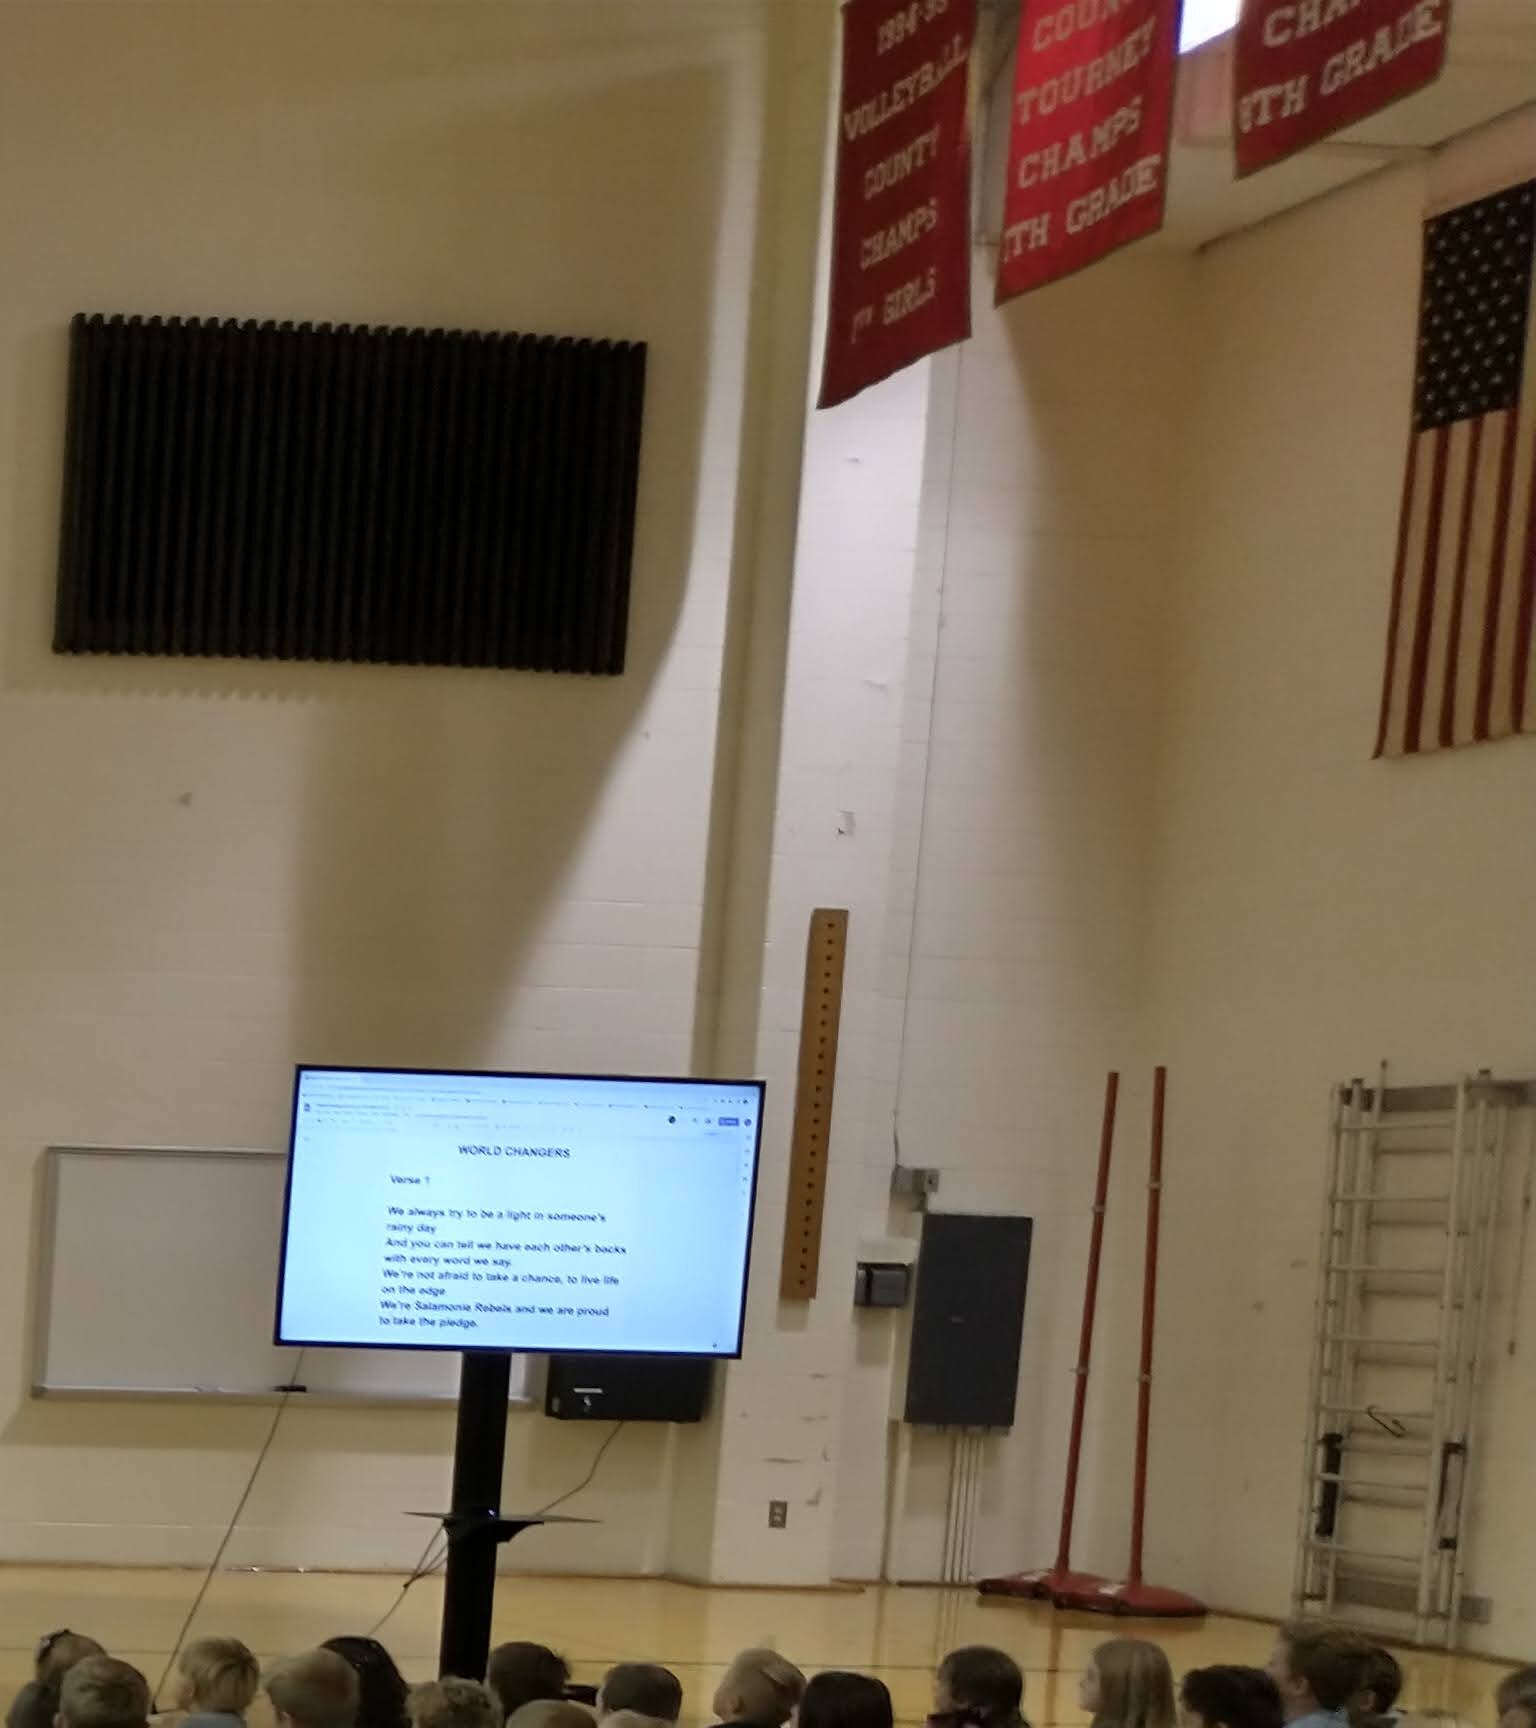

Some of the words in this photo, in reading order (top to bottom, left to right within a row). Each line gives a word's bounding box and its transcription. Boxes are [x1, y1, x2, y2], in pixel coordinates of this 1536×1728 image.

[1320, 0, 1442, 96] GRADE
[1016, 15, 1158, 126] TOURNEY
[1017, 95, 1143, 189] CHAMPS
[864, 122, 941, 200] COUNTY
[1066, 152, 1162, 235] GRADE
[860, 197, 938, 269] CHAMPS
[883, 265, 937, 325] GIRLS
[457, 1144, 503, 1157] WORLD
[504, 1146, 571, 1159] CHANGERS
[390, 1175, 421, 1185] Verse
[387, 1205, 405, 1216] We
[407, 1207, 446, 1219] always
[448, 1208, 464, 1220] try
[466, 1209, 478, 1219] to
[480, 1209, 495, 1219] be
[496, 1211, 504, 1220] a
[506, 1210, 532, 1222] light
[533, 1211, 545, 1221] in
[386, 1223, 414, 1234] rainy
[416, 1223, 437, 1235] day
[385, 1237, 408, 1248] And
[410, 1240, 431, 1249] you
[433, 1240, 455, 1249] can
[456, 1240, 474, 1249] tell
[476, 1242, 493, 1251] we
[495, 1240, 522, 1251] have
[523, 1242, 551, 1253] each
[594, 1243, 627, 1255] backs
[383, 1253, 408, 1264] with
[409, 1255, 440, 1267] every
[442, 1257, 471, 1266] word
[473, 1257, 490, 1266] we
[415, 1271, 435, 1281] not
[437, 1271, 470, 1281] afraid
[471, 1271, 484, 1282] to
[485, 1272, 510, 1282] take
[511, 1274, 519, 1283] a
[566, 1275, 579, 1285] to
[580, 1275, 601, 1285] live
[603, 1275, 620, 1285] life
[380, 1285, 396, 1295] on
[398, 1284, 416, 1295] the
[418, 1286, 446, 1298] edge
[413, 1299, 472, 1312] Salamonie
[474, 1302, 512, 1314] Rebels
[515, 1304, 536, 1314] and
[537, 1306, 554, 1316] we
[556, 1306, 575, 1316] are
[576, 1307, 610, 1318] proud
[378, 1315, 391, 1326] to
[392, 1316, 417, 1326] take
[418, 1316, 437, 1327] the
